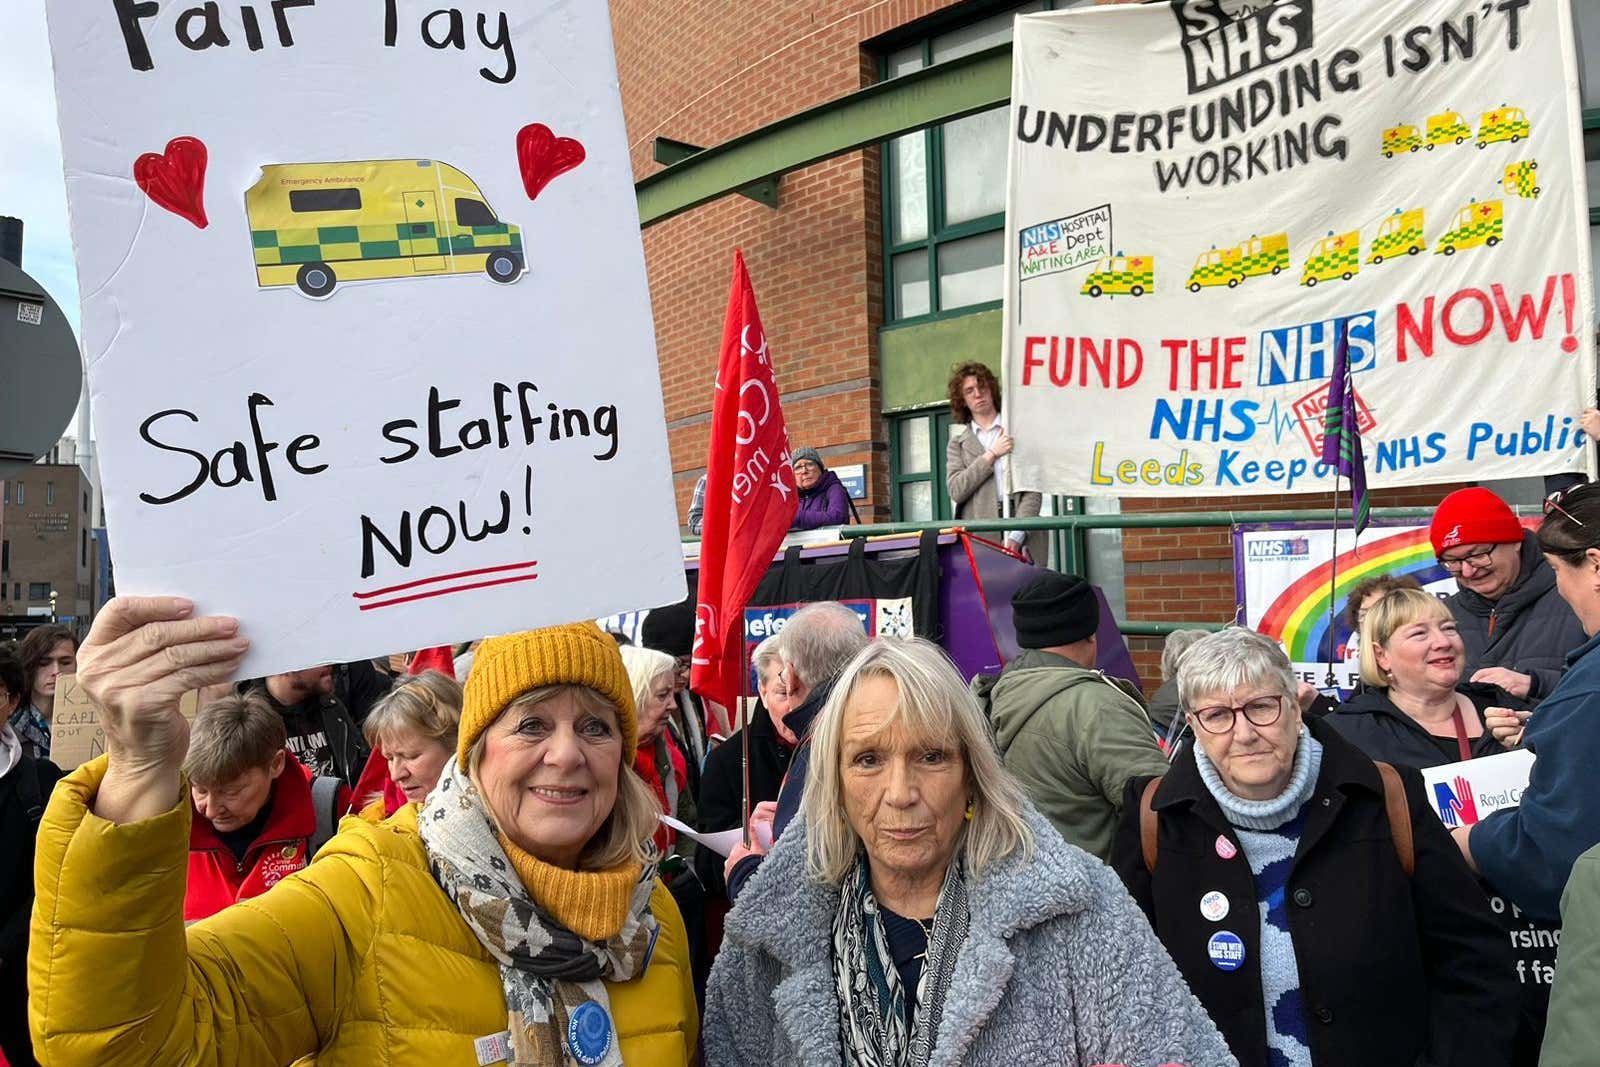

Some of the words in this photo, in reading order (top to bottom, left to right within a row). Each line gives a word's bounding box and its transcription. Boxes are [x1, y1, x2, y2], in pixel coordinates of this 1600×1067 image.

[1187, 4, 1302, 86] NHS
[1017, 47, 1361, 154] UNDERFUNDING
[1385, 2, 1529, 77] ISN'T
[1155, 116, 1348, 192] WORKING
[281, 178, 322, 186] Emergency
[324, 176, 365, 184] Ambulance
[1023, 223, 1059, 248] NHS
[1061, 211, 1109, 234] HOSPITAL
[1028, 241, 1059, 259] A&E
[1067, 228, 1104, 250] Dept
[1021, 253, 1072, 274] WAITING
[1075, 245, 1105, 263] AREA
[1022, 336, 1143, 388] FUND
[1161, 336, 1246, 391] THE
[1262, 315, 1375, 386] NHS
[1396, 273, 1578, 363] NOW!
[139, 392, 329, 505] Safe
[380, 381, 618, 464] staffing
[1150, 398, 1260, 441] NHS
[1091, 441, 1204, 486] Leeds
[1215, 449, 1307, 489] Keep
[1376, 434, 1446, 474] NHS
[361, 464, 532, 578] NOW!
[1249, 540, 1284, 556] NHS
[1480, 790, 1509, 810] Royal
